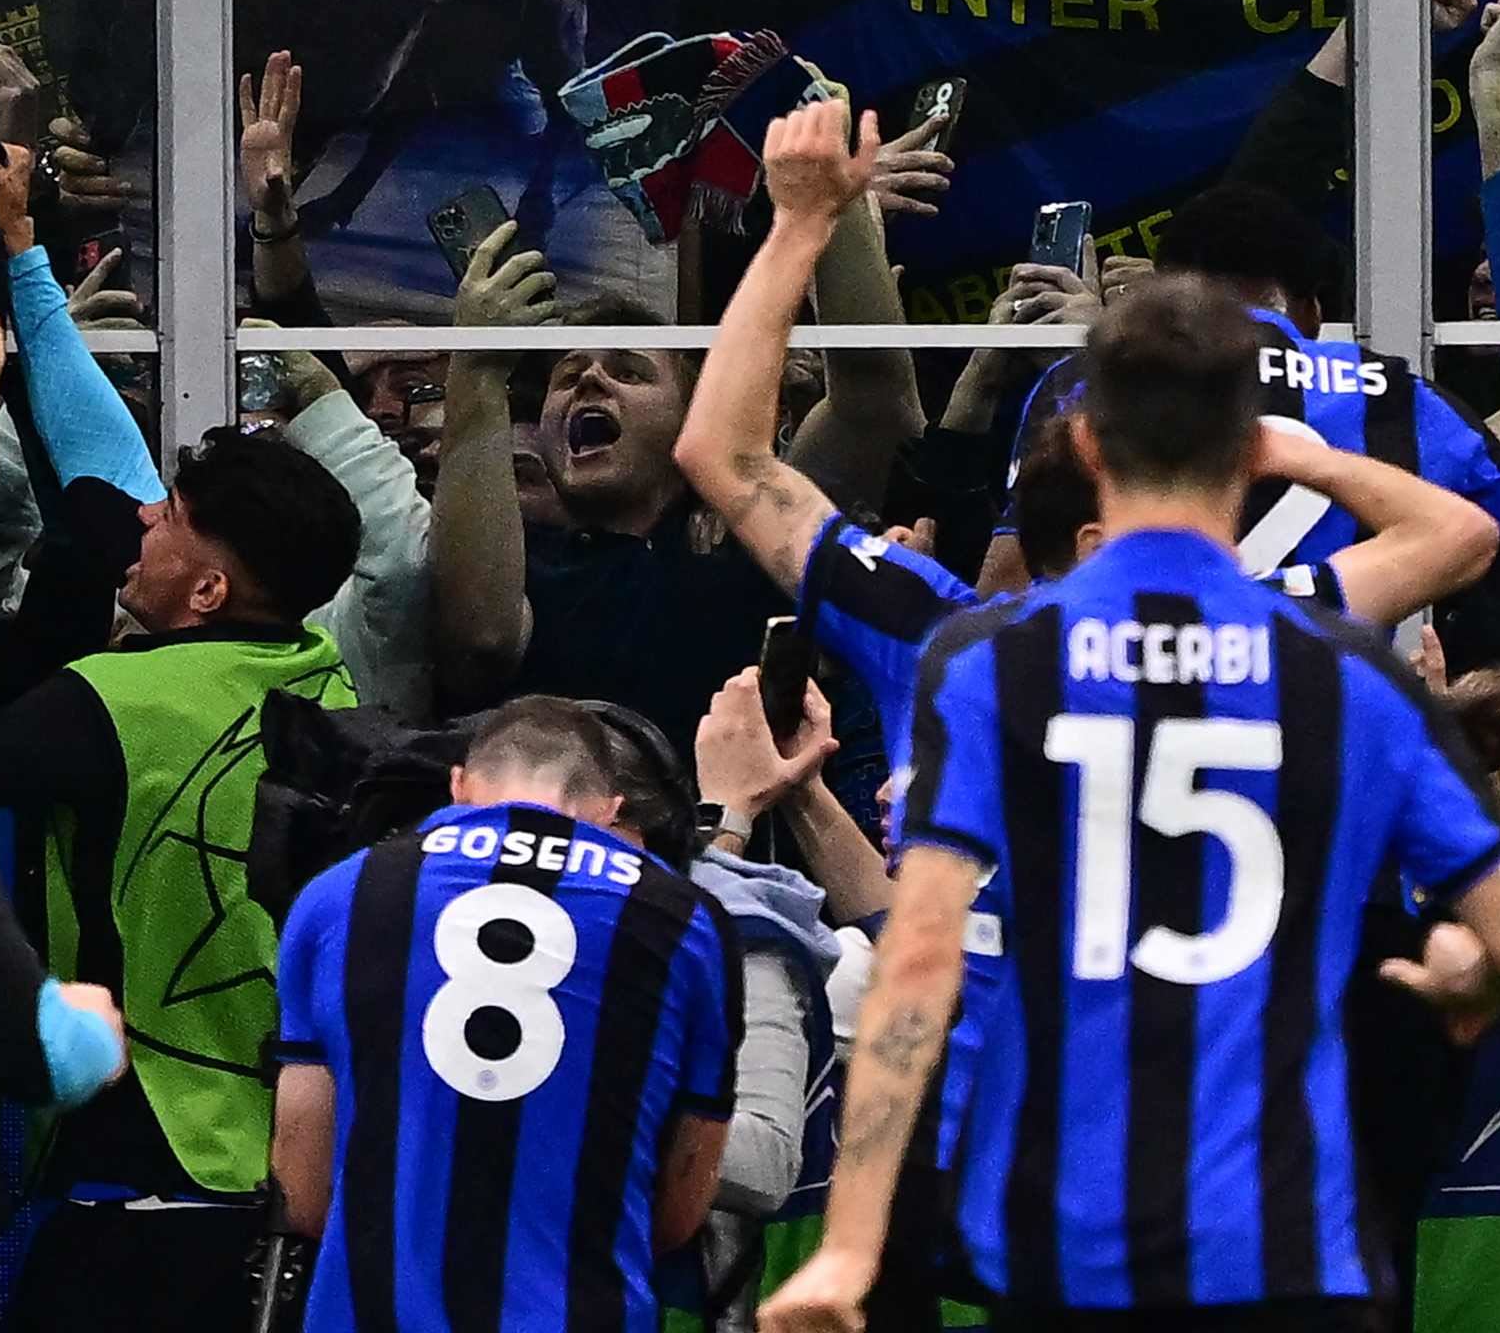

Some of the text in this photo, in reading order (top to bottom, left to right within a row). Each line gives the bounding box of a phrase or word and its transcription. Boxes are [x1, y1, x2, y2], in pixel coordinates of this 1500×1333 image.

[1067, 617, 1271, 686] ACERBI
[420, 824, 644, 887] GOSENS
[1043, 713, 1285, 986] 15
[420, 881, 579, 1103] 8
